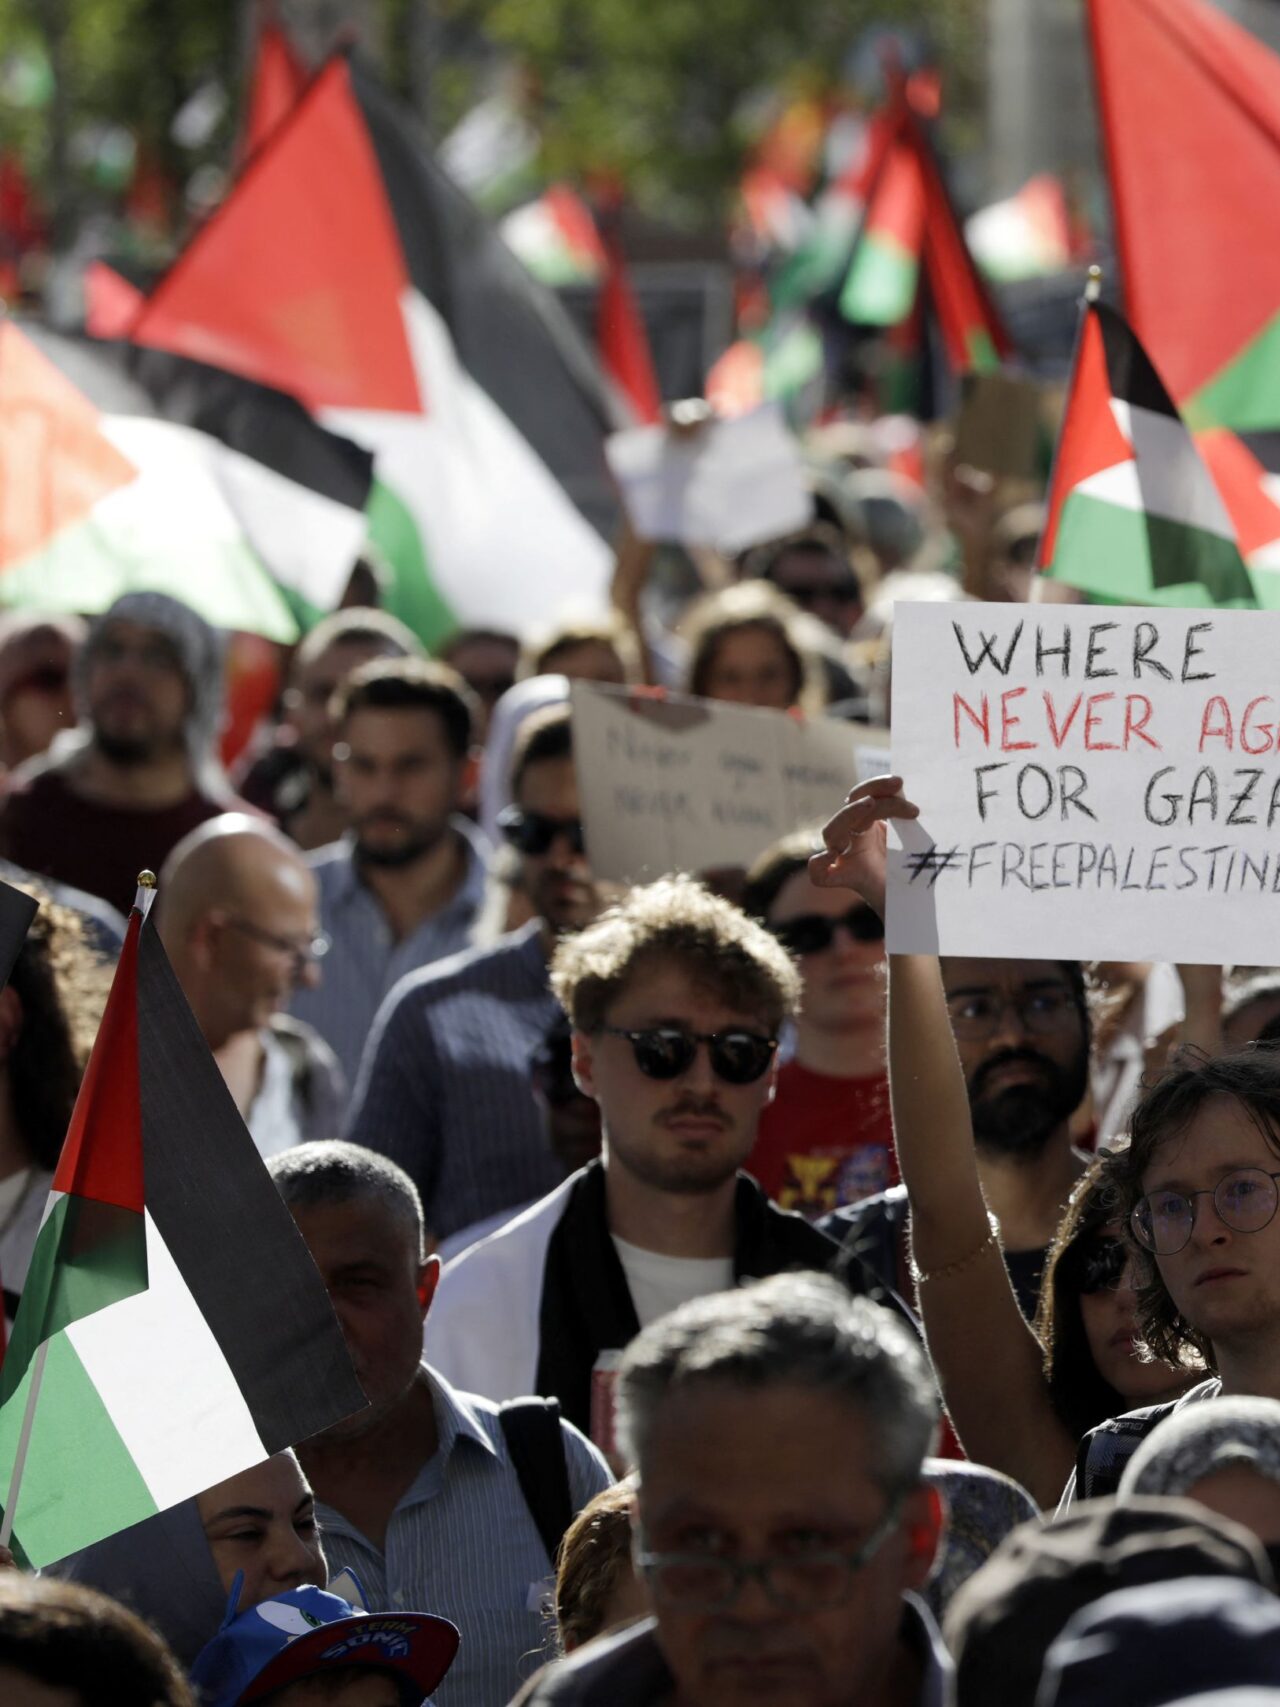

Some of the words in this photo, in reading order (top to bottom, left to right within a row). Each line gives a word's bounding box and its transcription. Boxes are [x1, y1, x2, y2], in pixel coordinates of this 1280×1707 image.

[952, 619, 1216, 683] WHERE
[952, 687, 1163, 752] NEVER
[973, 761, 1098, 822] FOR
[320, 1631, 409, 1658] SONIC
[349, 1621, 418, 1634] TEAM
